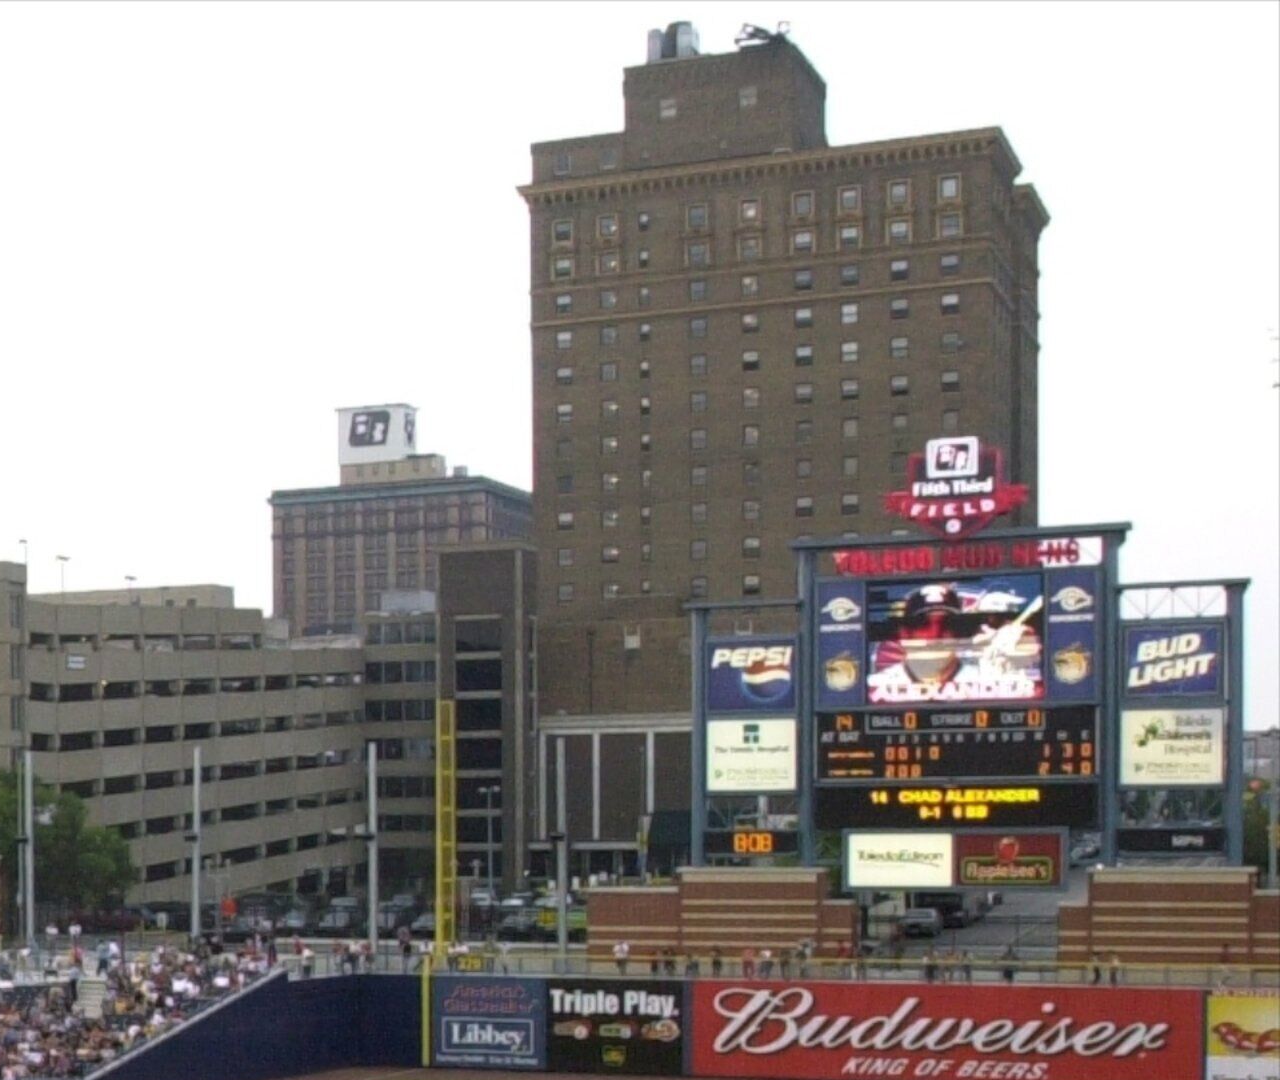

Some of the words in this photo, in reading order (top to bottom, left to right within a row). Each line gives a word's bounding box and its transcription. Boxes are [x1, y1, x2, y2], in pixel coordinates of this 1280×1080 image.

[952, 477, 993, 495] Third
[910, 499, 995, 517] FIELD
[711, 646, 793, 669] PEPSI
[1136, 633, 1201, 662] BUD
[1127, 653, 1216, 688] LIGHT
[898, 789, 942, 804] CHAD
[945, 788, 1040, 803] ALEXANDER
[966, 862, 1047, 880] Applebee's
[550, 989, 619, 1016] Triple
[624, 989, 679, 1018] Play.
[713, 987, 1169, 1057] Budweiser
[450, 1022, 525, 1049] Libbey
[840, 1056, 909, 1075] KING
[914, 1058, 954, 1077] OF
